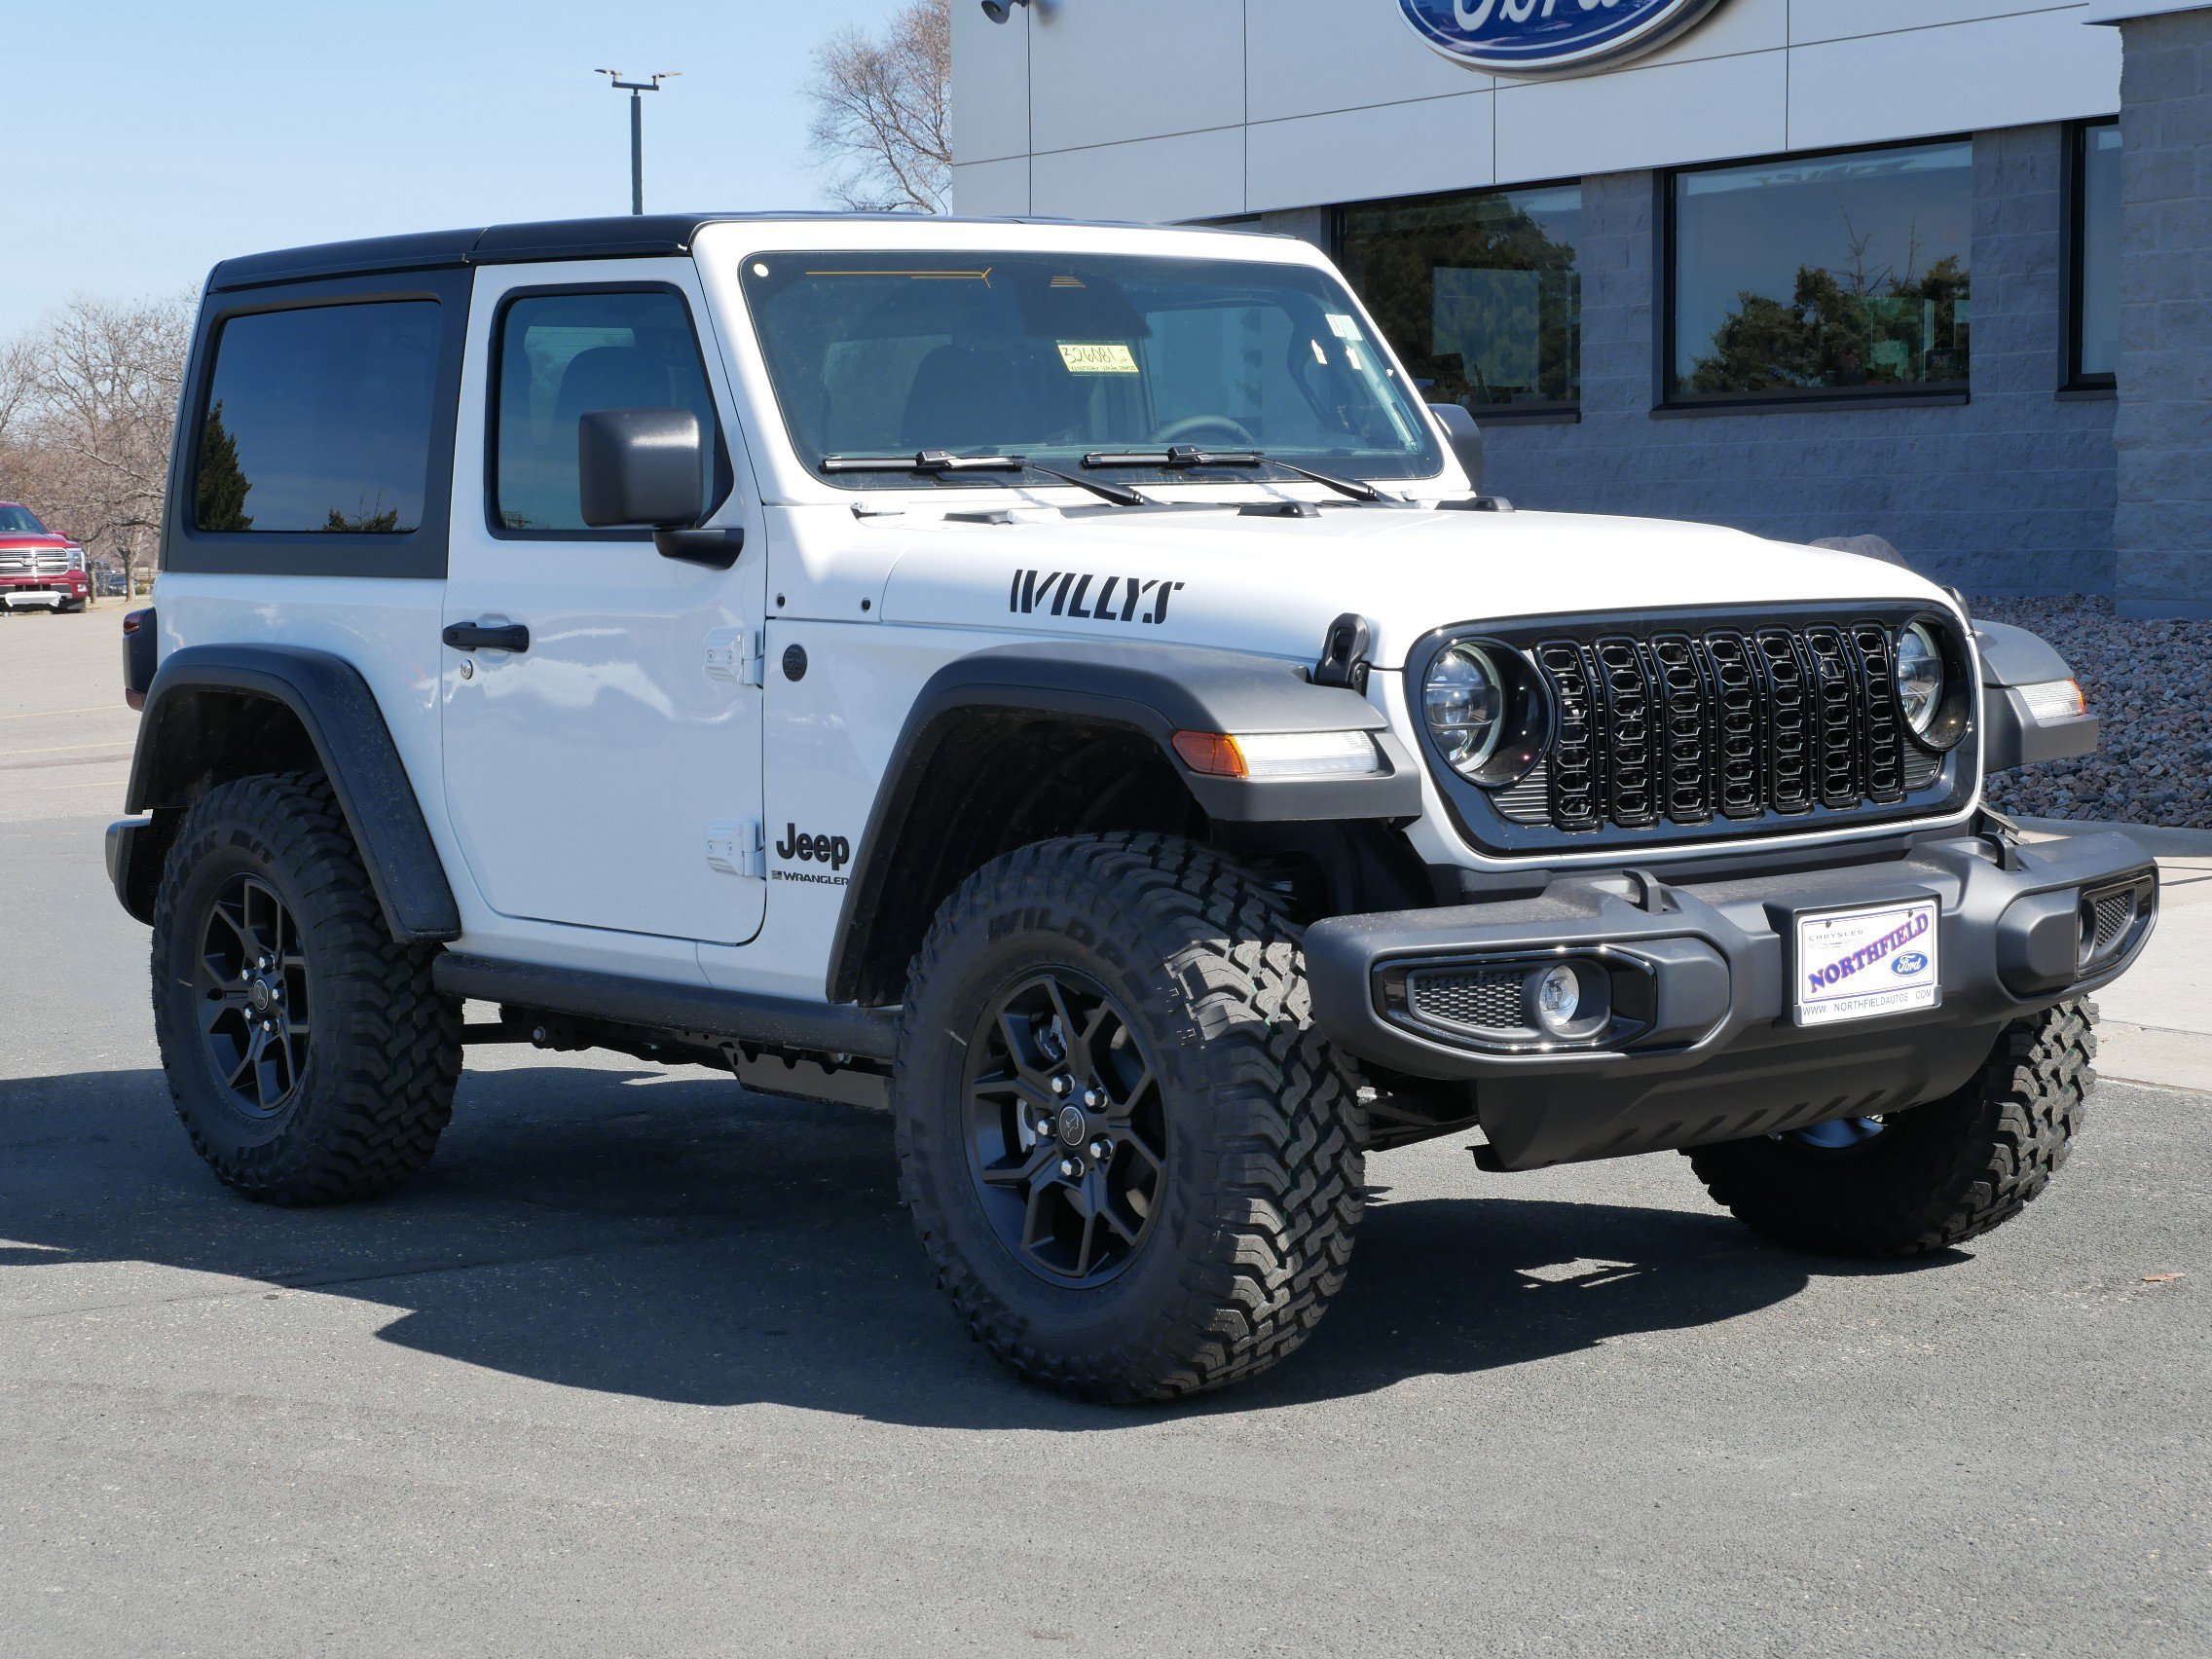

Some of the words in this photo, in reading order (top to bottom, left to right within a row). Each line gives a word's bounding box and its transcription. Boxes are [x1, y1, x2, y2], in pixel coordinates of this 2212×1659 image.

[1010, 569, 1185, 625] WILLYS
[775, 822, 850, 871] Jeep
[783, 870, 849, 885] WRANGLER
[1808, 930, 1863, 941] CHRYSLER
[1808, 912, 1929, 993] NORTHFIELD
[1897, 954, 1922, 973] Ford
[1833, 993, 1908, 1012] NORTHFIELDAUTOS
[1915, 988, 1932, 1000] COM
